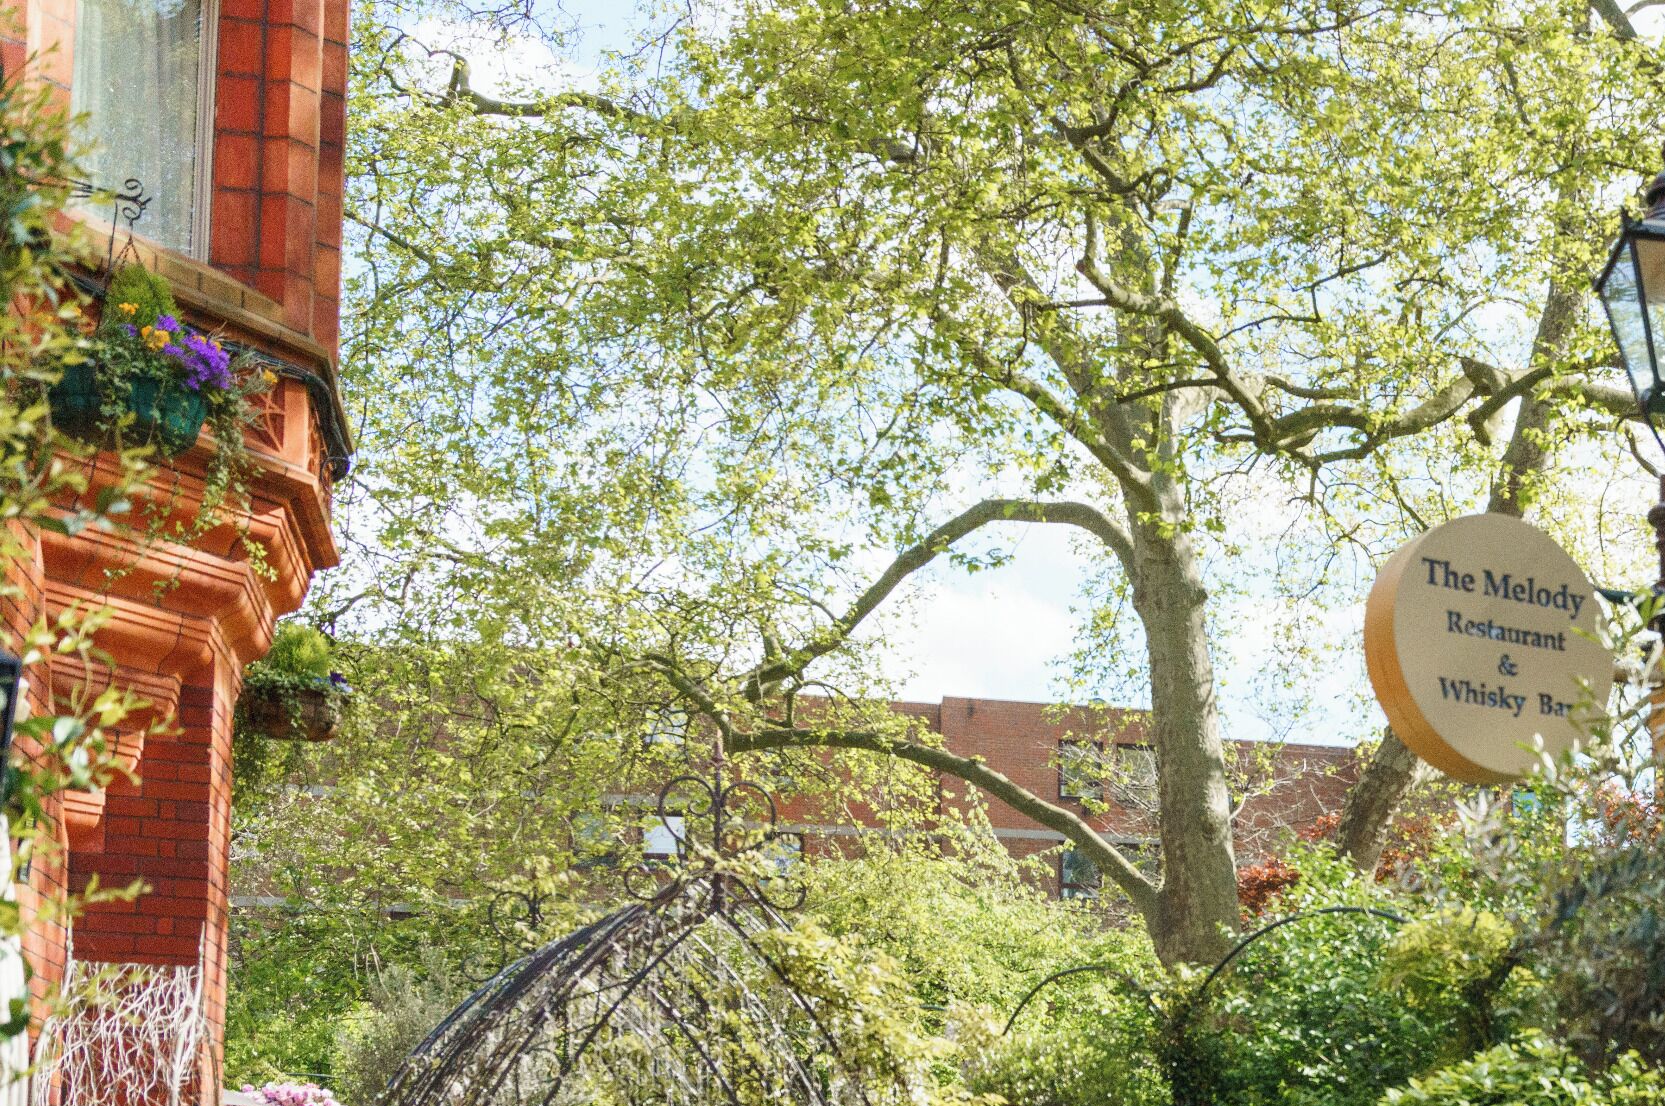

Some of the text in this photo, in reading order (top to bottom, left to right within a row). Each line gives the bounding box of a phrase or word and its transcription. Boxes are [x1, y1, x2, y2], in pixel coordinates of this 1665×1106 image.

[1421, 557, 1585, 619] The Melody
[1446, 610, 1566, 651] Restaurant
[1497, 654, 1518, 676] &
[1438, 676, 1526, 717] Whisky
